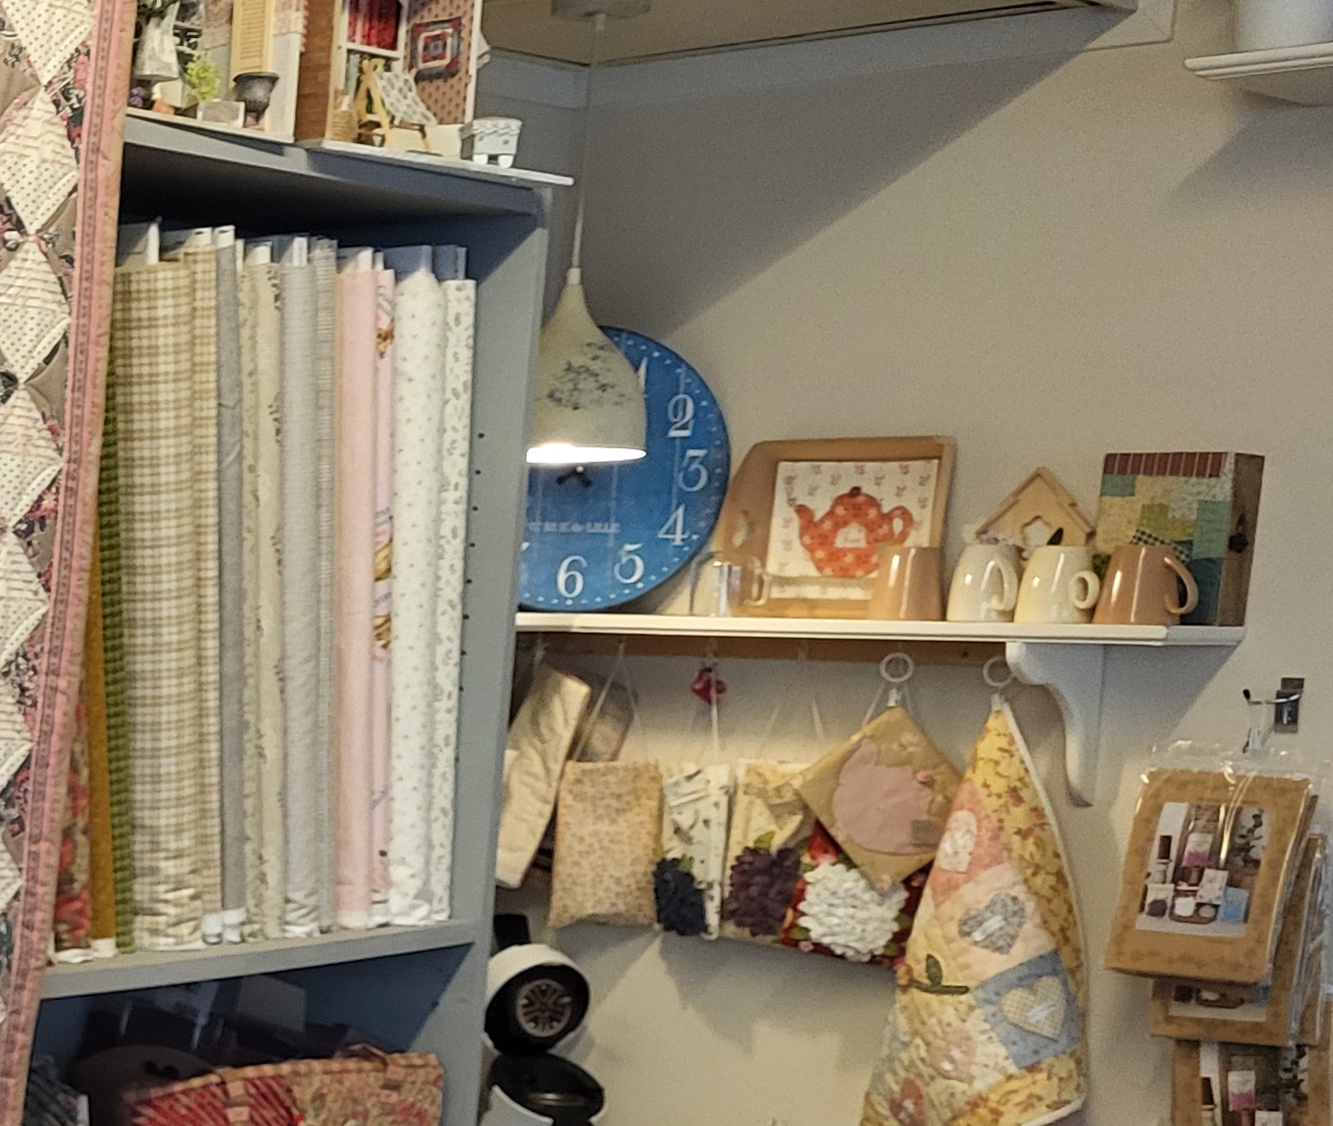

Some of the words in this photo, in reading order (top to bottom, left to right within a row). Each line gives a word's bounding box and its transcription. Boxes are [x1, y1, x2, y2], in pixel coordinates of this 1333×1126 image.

[666, 394, 695, 438] 2
[678, 449, 709, 491] 3
[657, 503, 690, 546] 4
[556, 555, 588, 598] 6
[614, 543, 646, 584] 5
